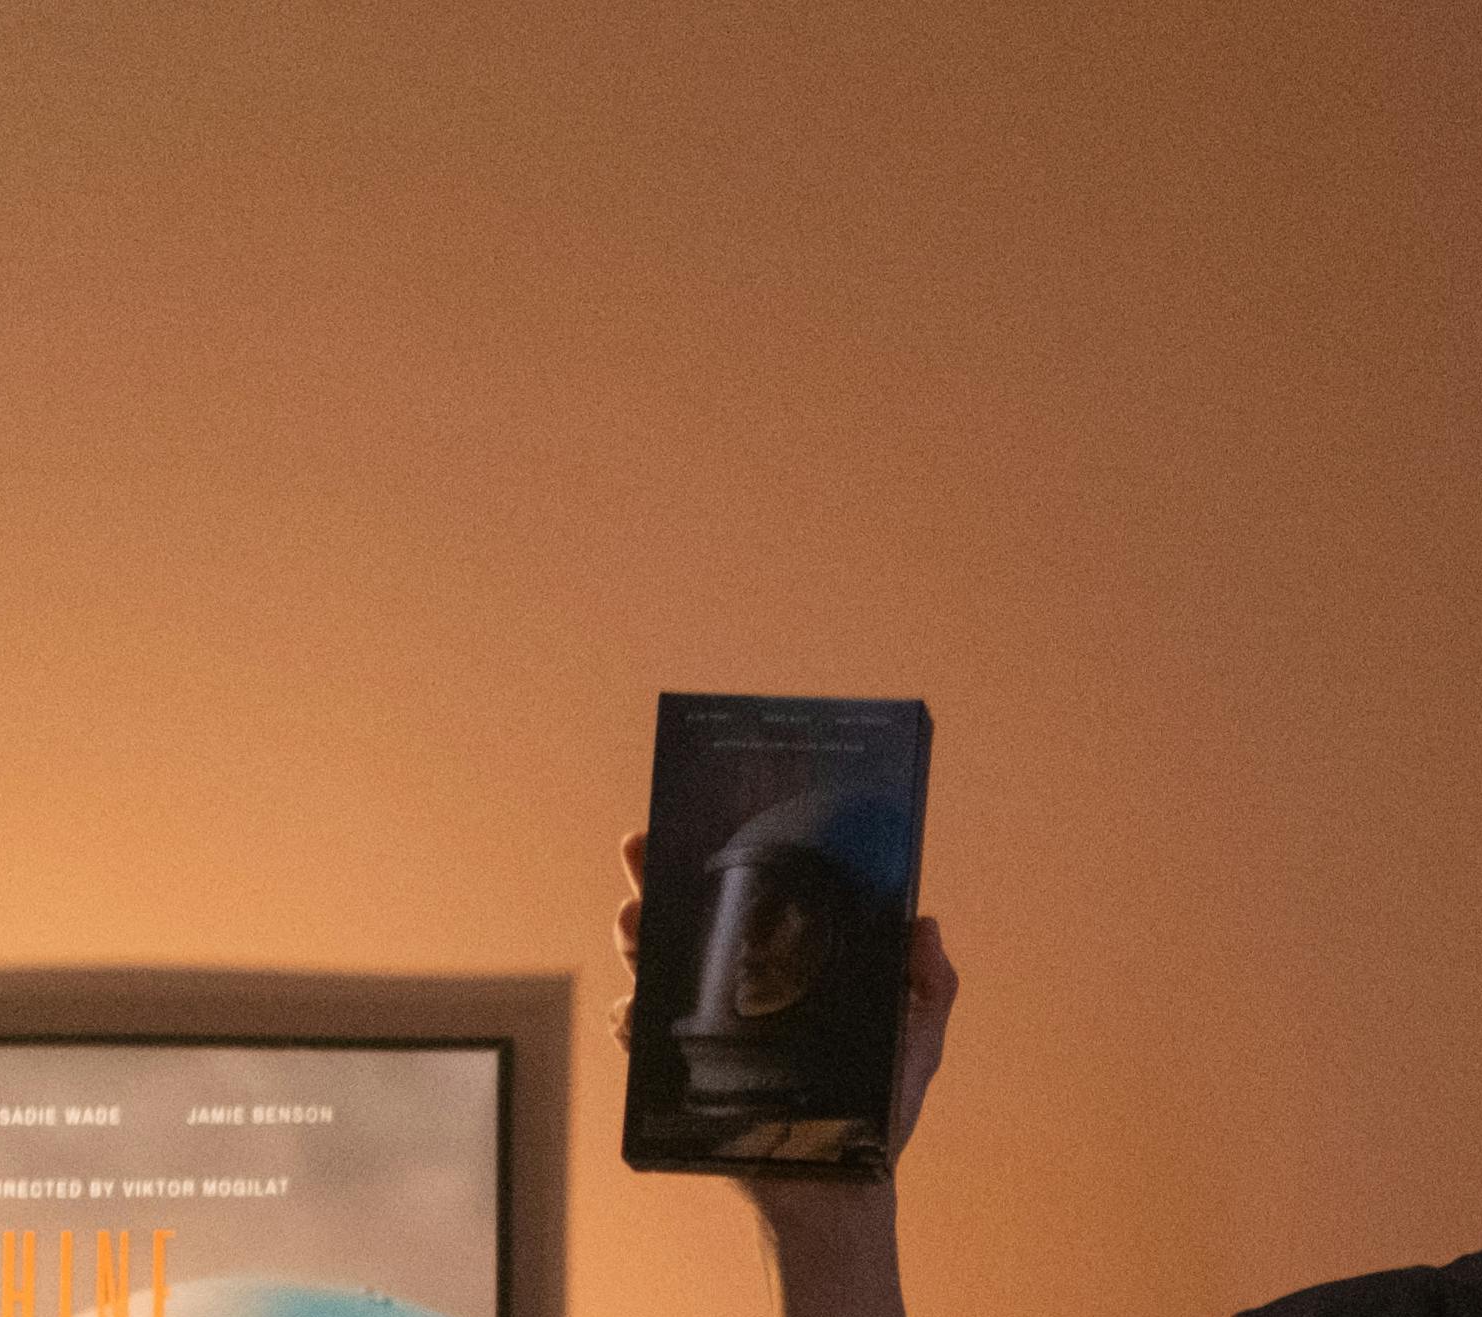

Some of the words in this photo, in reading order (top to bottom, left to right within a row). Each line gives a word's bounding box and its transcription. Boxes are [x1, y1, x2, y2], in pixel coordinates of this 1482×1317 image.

[64, 1105, 120, 1126] WADE
[186, 1105, 245, 1126] JAMIE
[251, 1105, 334, 1125] BENSON
[89, 1178, 115, 1198] BY
[121, 1178, 196, 1198] VIKTOR
[203, 1177, 290, 1197] MOGILAT
